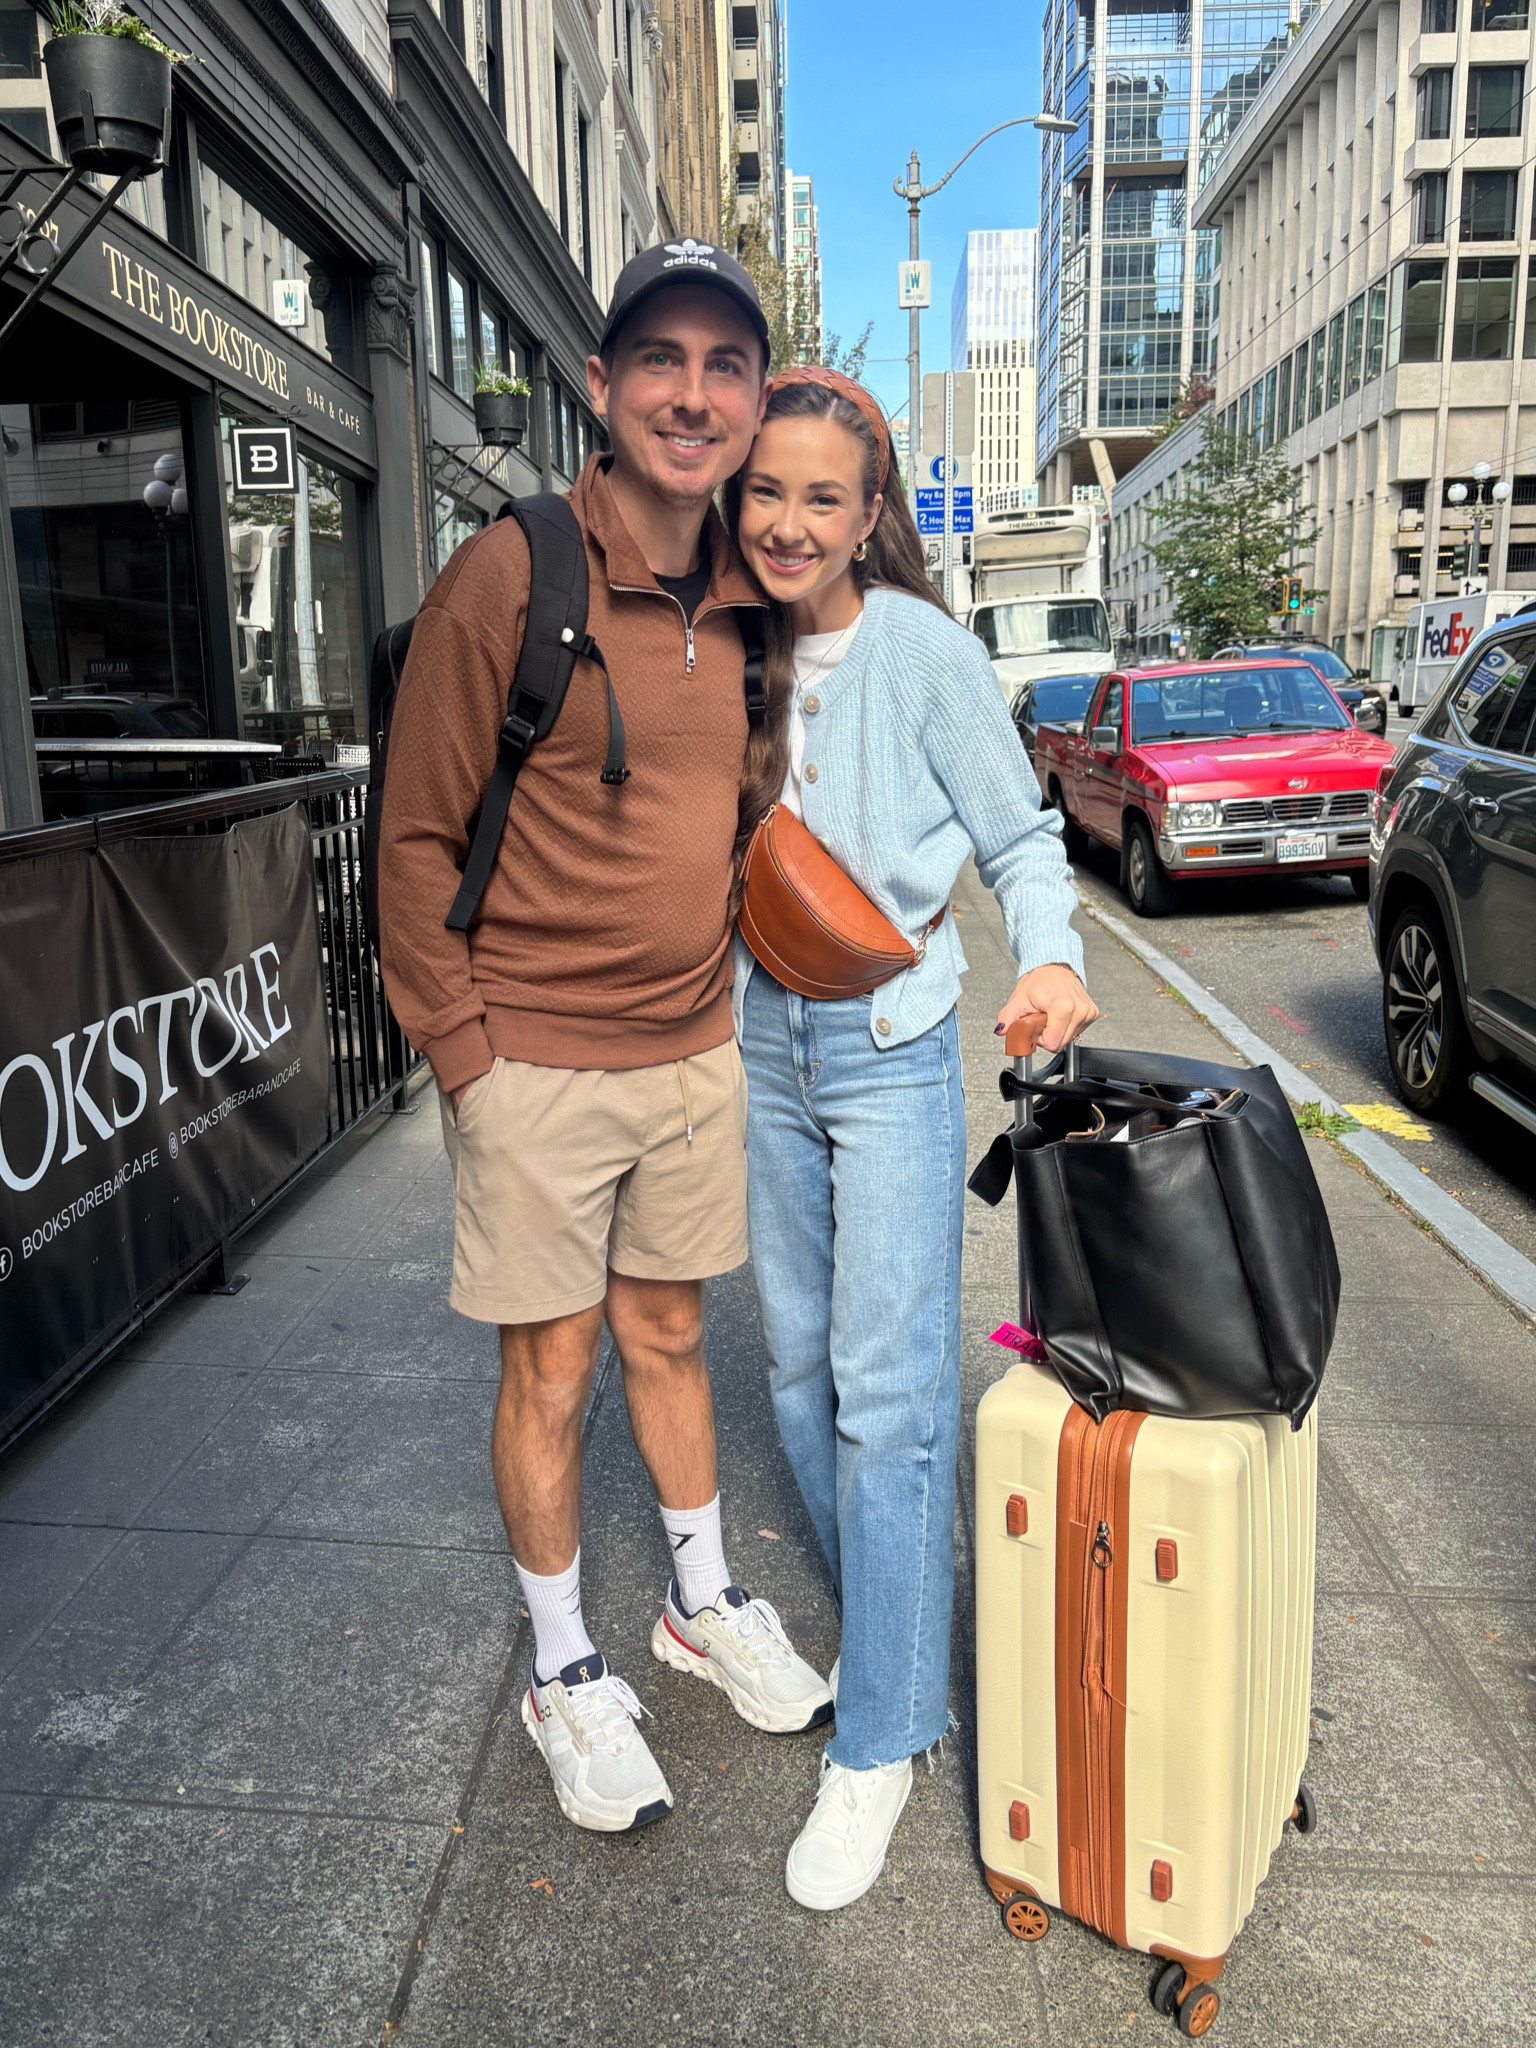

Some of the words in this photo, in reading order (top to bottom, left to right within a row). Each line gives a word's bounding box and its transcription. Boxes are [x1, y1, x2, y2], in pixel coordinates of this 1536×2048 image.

[663, 254, 718, 270] adidas
[102, 241, 164, 325] THE
[166, 283, 290, 401] BOOKSTORE
[306, 385, 325, 414] BAR
[329, 401, 335, 420] &
[338, 407, 361, 436] CAFÉ
[918, 491, 933, 501] Pay
[919, 512, 927, 525] 2
[928, 516, 944, 525] Hou
[954, 514, 971, 523] Max
[1008, 521, 1038, 529] THERMO
[1422, 611, 1475, 659] FedEx
[180, 1057, 301, 1145] BOOKSTOREBARANDCAFE
[21, 1147, 160, 1260] BOOKSTOREBARCAFE
[1001, 1329, 1048, 1357] TRAN
